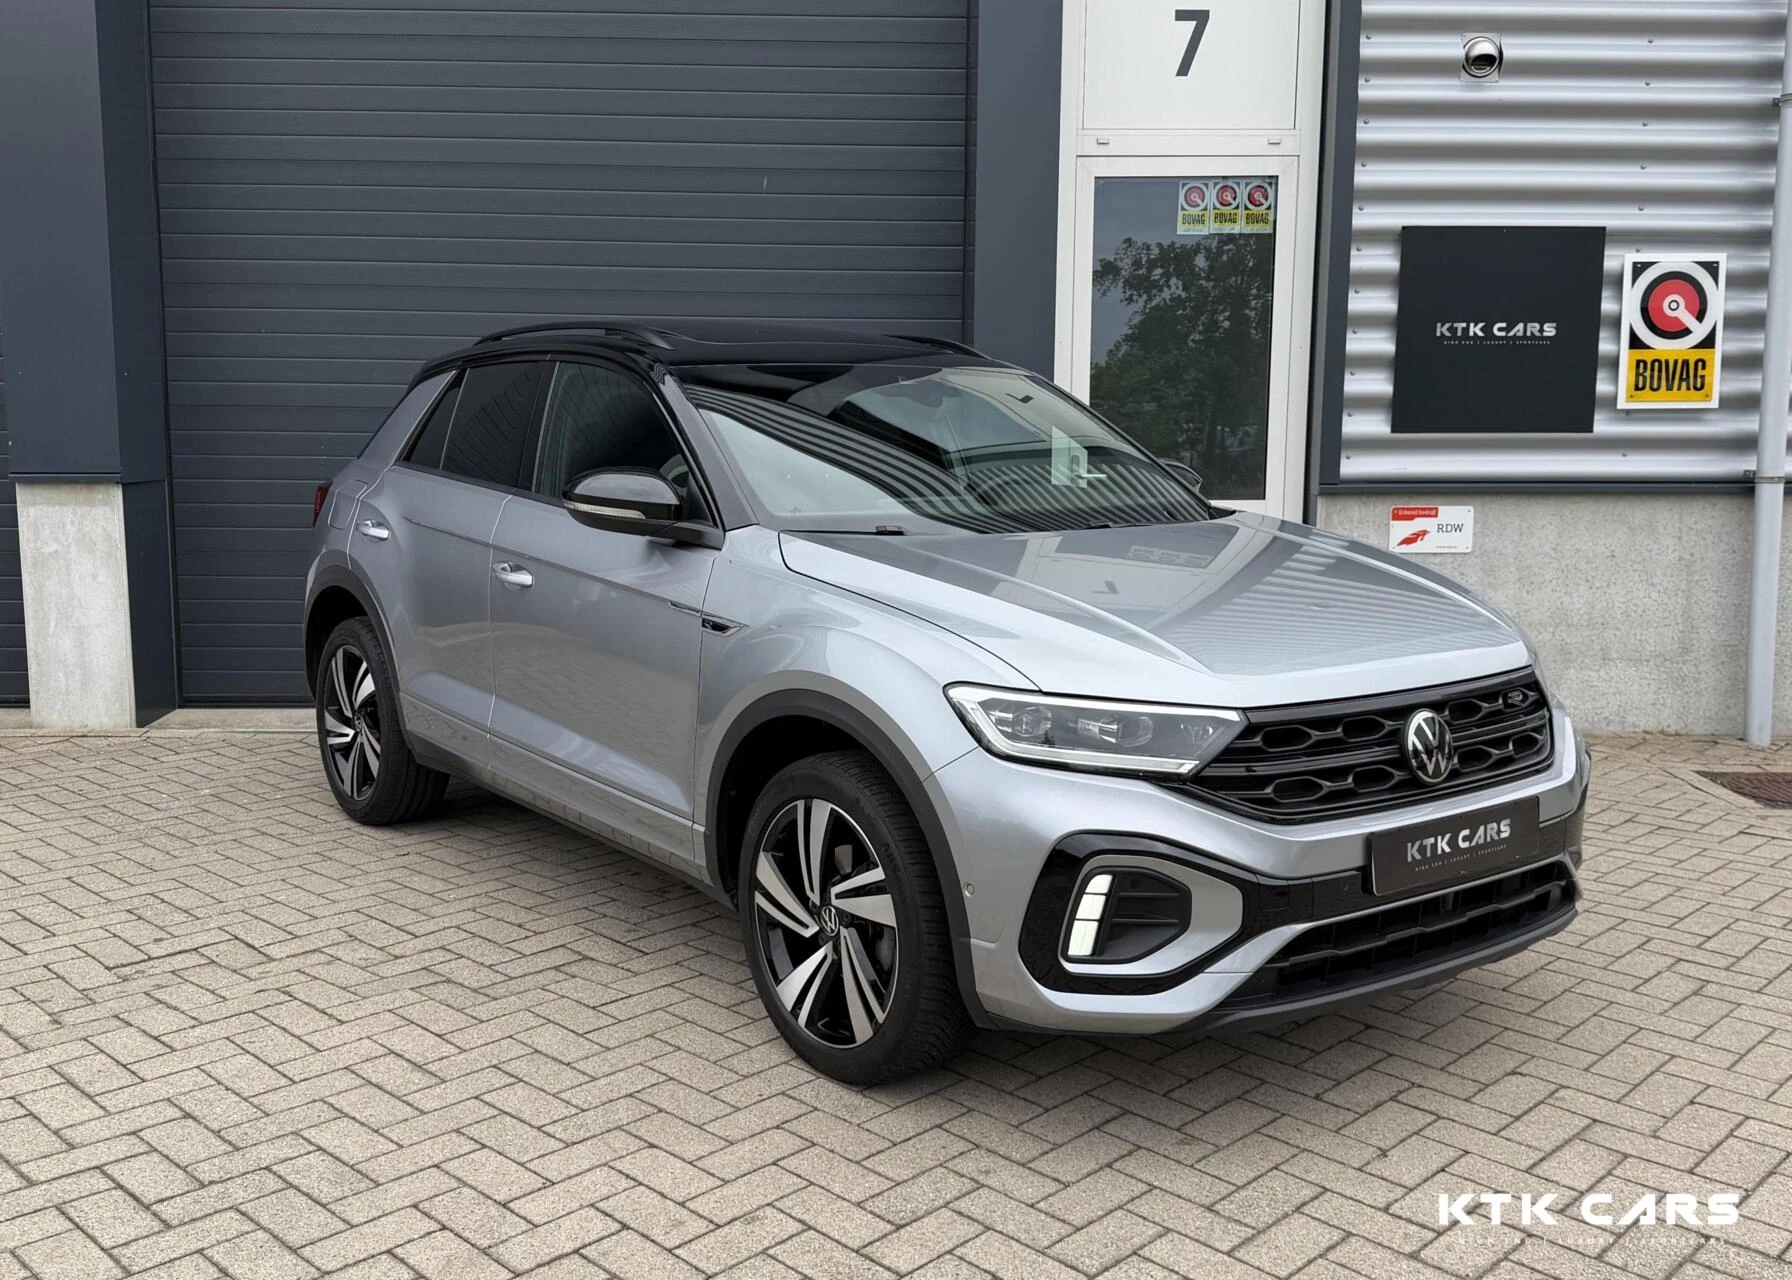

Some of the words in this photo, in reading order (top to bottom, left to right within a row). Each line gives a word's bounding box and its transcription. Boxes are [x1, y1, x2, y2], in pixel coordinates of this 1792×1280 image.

[1174, 9, 1210, 77] 7
[1182, 213, 1206, 225] BOVAG
[1214, 212, 1238, 224] BOVAG
[1245, 212, 1269, 225] BOVAG
[1436, 322, 1486, 337] KTK
[1492, 322, 1557, 337] CARS
[1634, 358, 1707, 392] BOVAG
[1436, 523, 1464, 533] RDW
[1407, 833, 1452, 862] KTK
[1458, 818, 1511, 849] CARS
